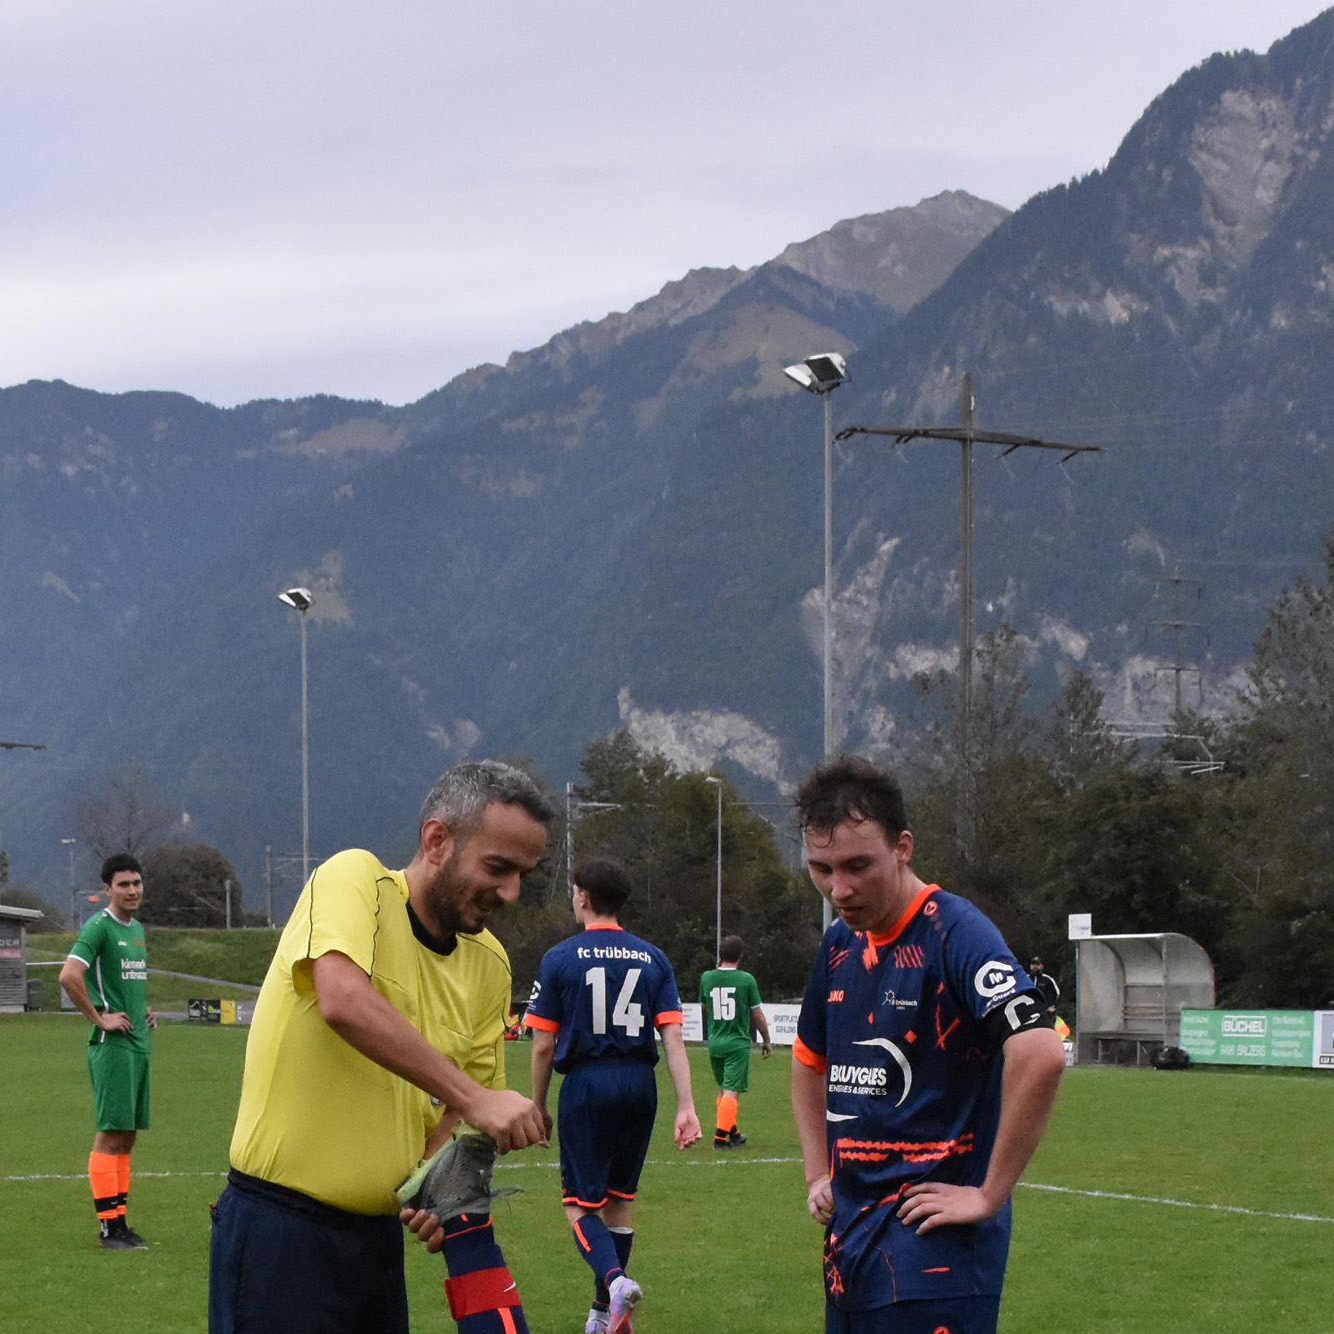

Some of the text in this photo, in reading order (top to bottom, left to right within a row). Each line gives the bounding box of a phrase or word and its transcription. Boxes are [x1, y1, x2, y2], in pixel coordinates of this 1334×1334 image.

[577, 946, 652, 964] fc trübbach
[585, 966, 645, 1037] 14
[709, 986, 736, 1021] 15
[1223, 1017, 1265, 1032] BÜCHEL
